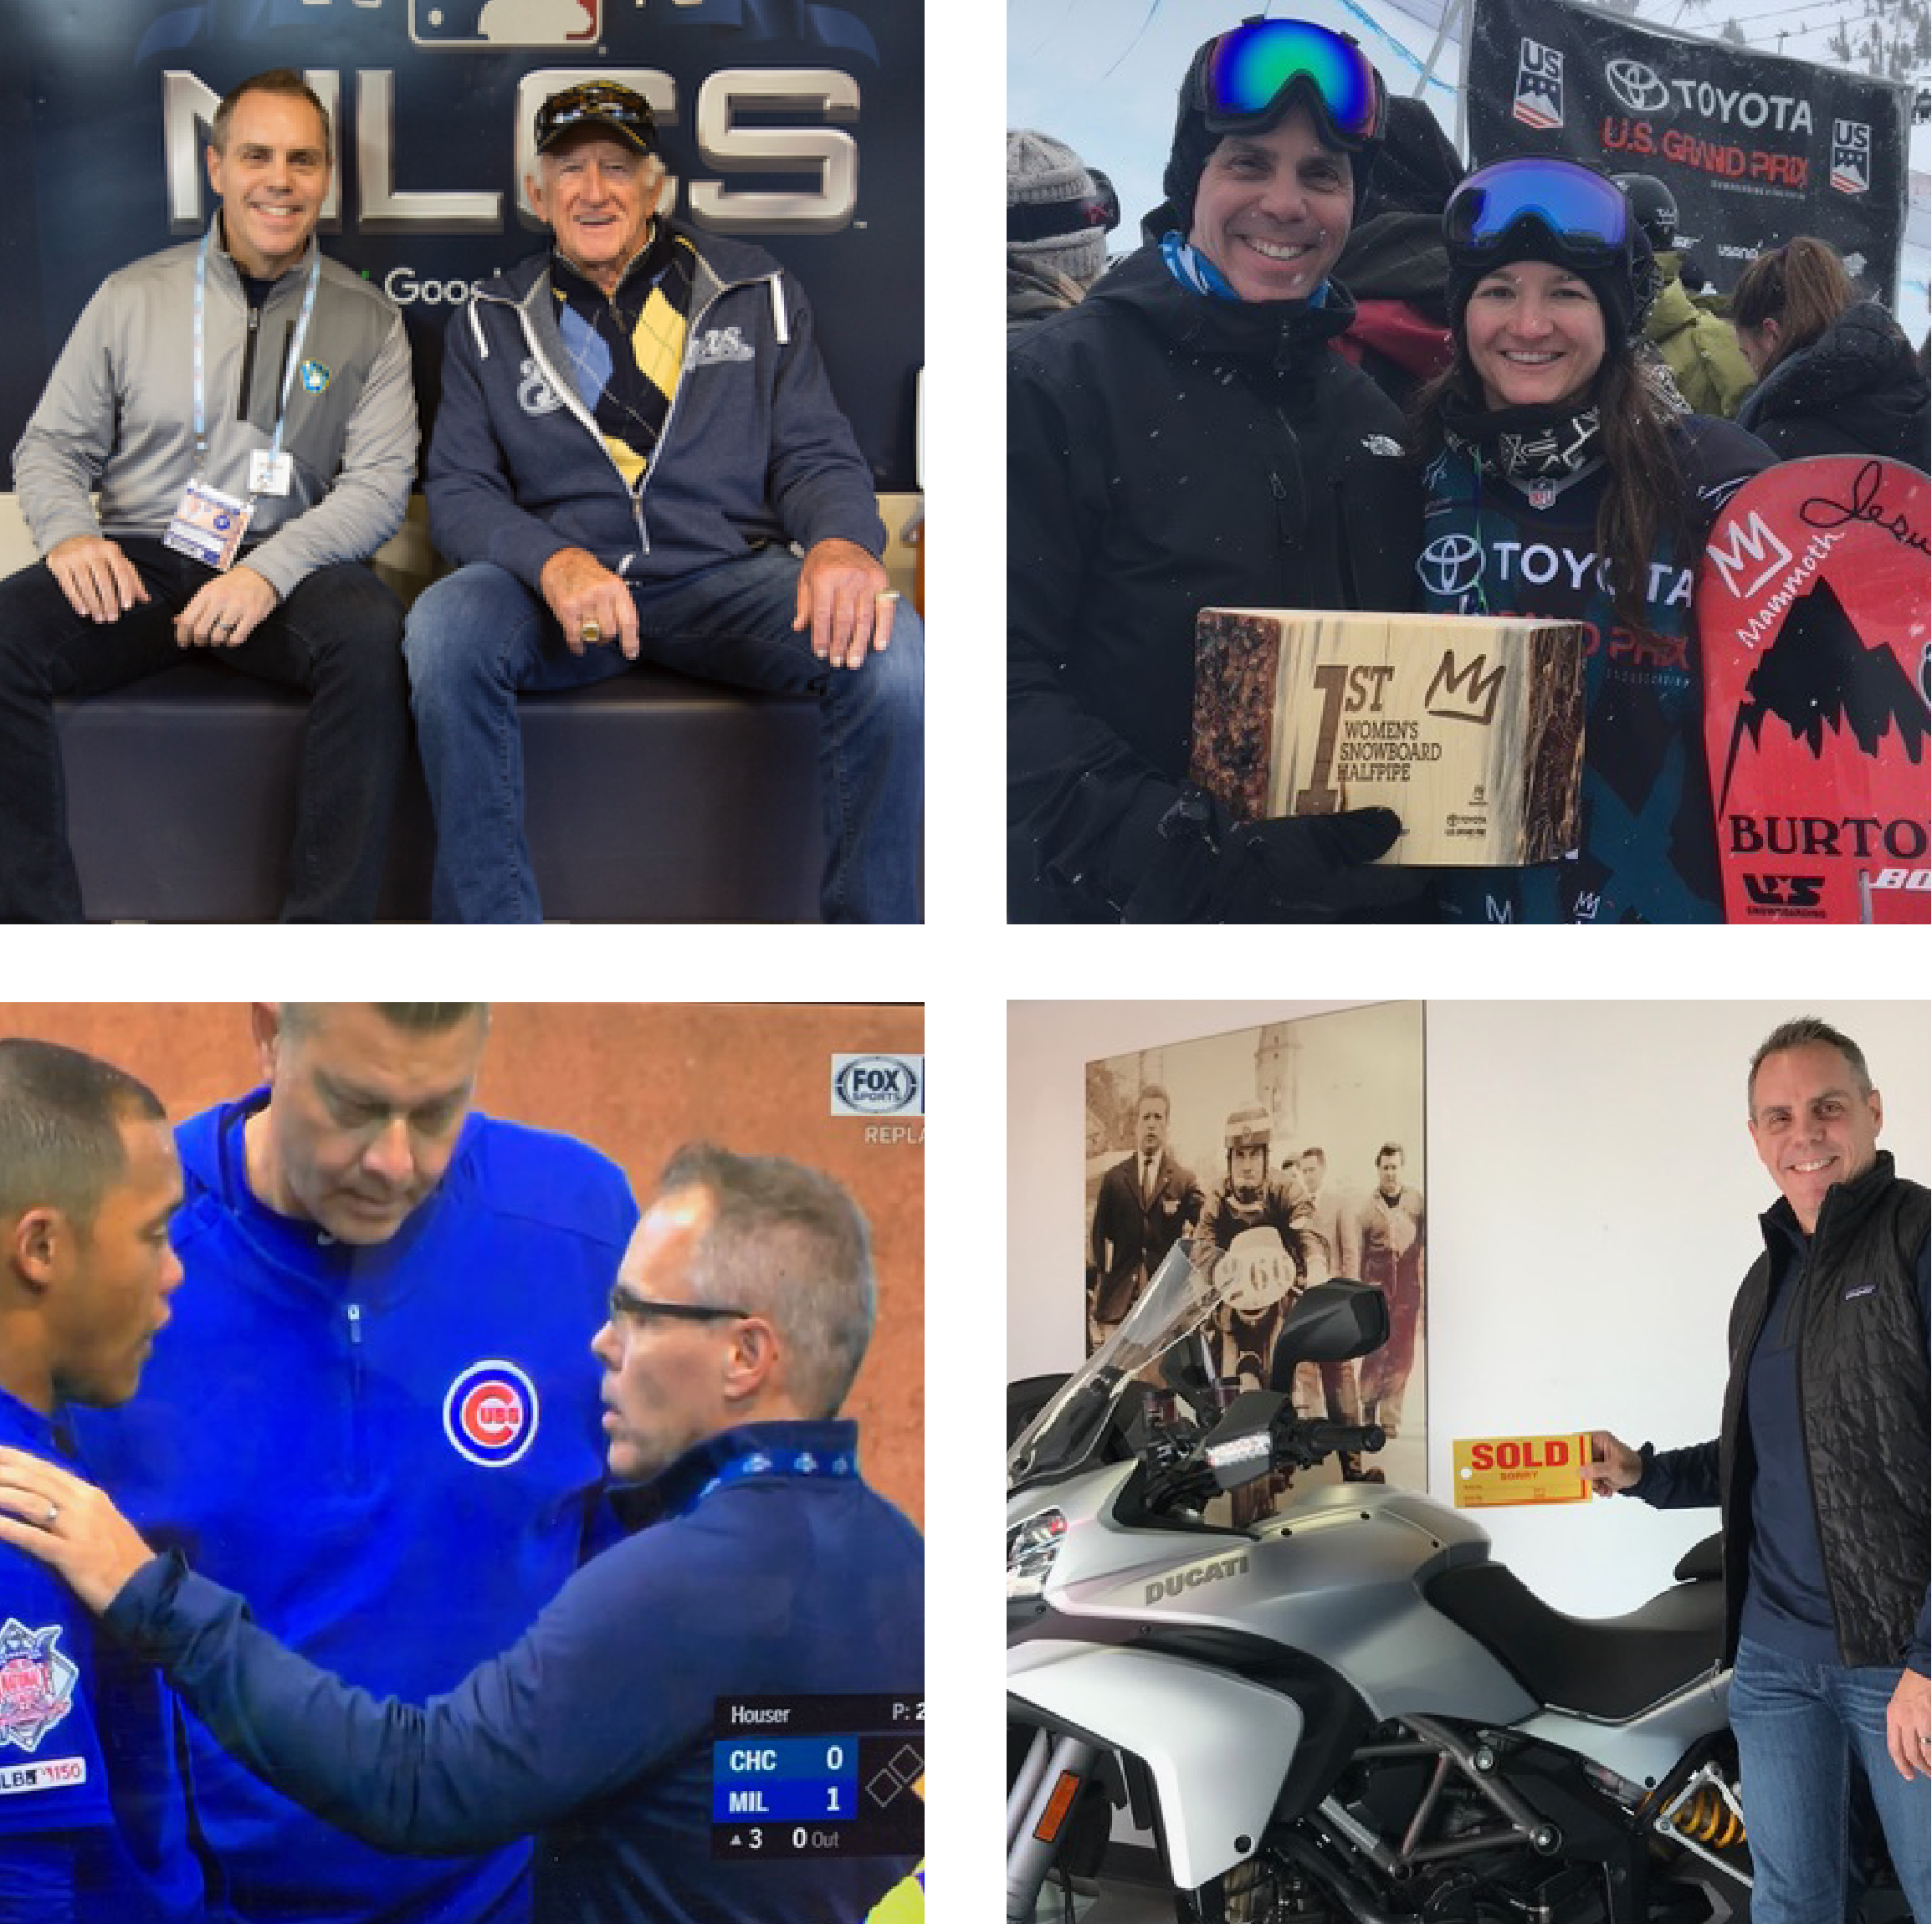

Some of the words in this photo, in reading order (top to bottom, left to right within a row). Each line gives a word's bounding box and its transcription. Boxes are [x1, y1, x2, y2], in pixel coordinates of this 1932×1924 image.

[1672, 79, 1814, 136] TOYOTA
[1601, 116, 1658, 155] U.S.
[1662, 129, 1745, 178] GRAND
[1737, 531, 1845, 650] Mammoth
[1345, 719, 1419, 739] WOMEN'S
[1339, 742, 1443, 762] SNOWBOARD
[1337, 762, 1411, 782] HALFPIPE
[1728, 814, 1931, 860] BURTO
[853, 1068, 900, 1091] FOX
[1471, 1441, 1570, 1471] SOLD
[1145, 1556, 1250, 1606] DUCATI
[730, 1705, 791, 1725] Houser
[729, 1748, 779, 1773] CHC
[826, 1744, 844, 1771] 0
[729, 1789, 771, 1814] MIL
[826, 1786, 843, 1813] 1
[748, 1826, 763, 1850] 3
[792, 1826, 807, 1850] 0
[810, 1830, 840, 1850] Out
